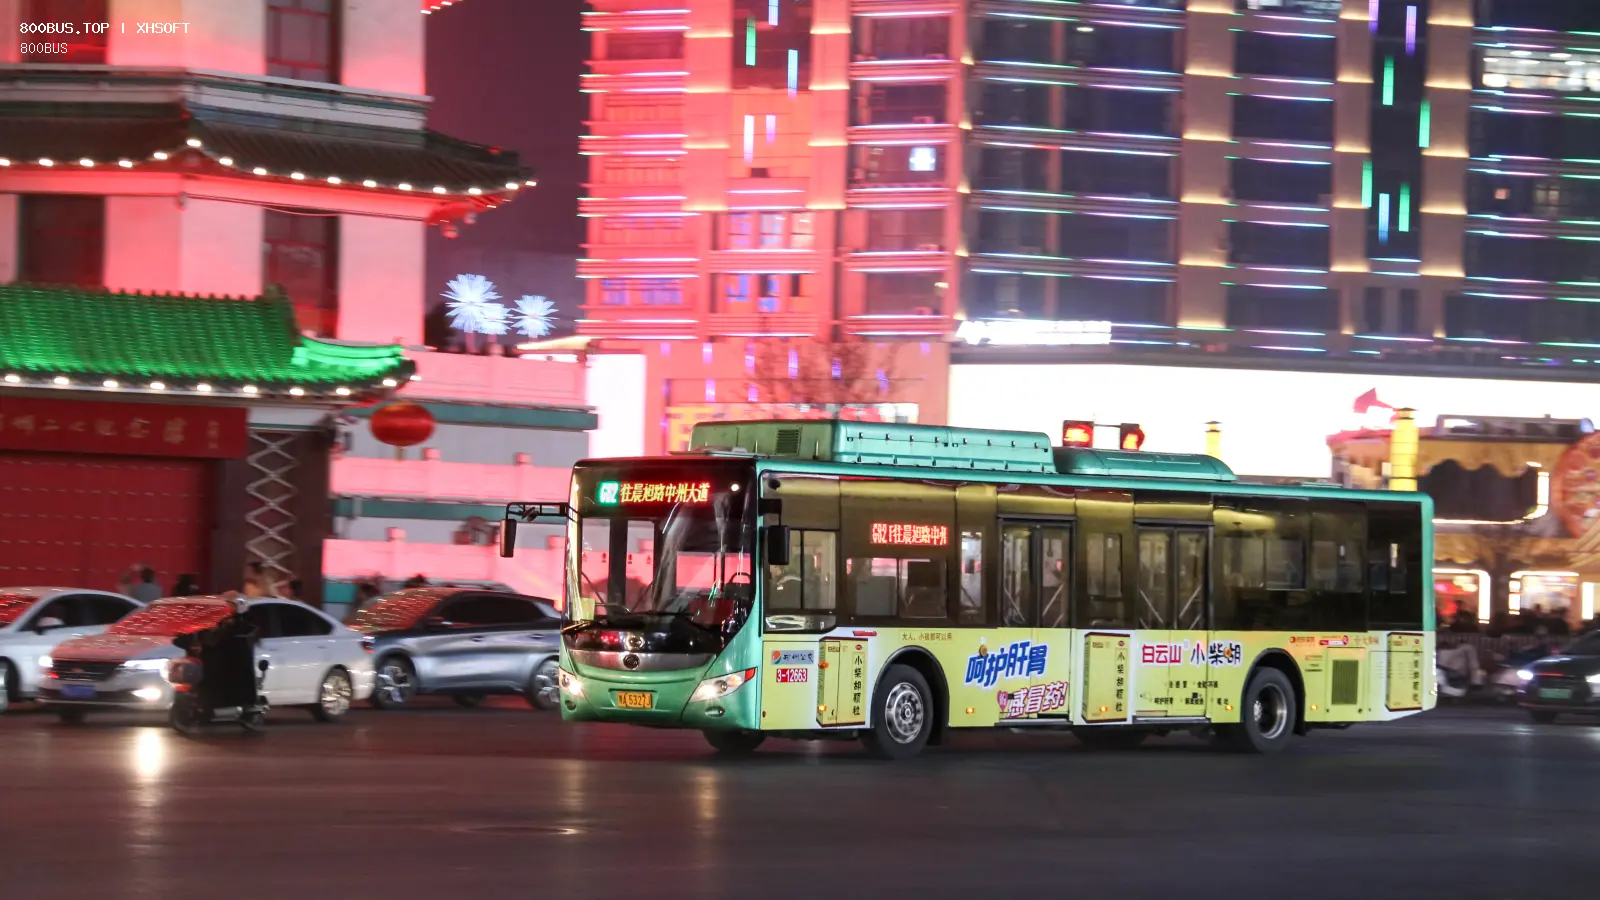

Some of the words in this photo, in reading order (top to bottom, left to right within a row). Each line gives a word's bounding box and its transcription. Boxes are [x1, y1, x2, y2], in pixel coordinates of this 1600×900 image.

[620, 483, 710, 503] 往晨旭路中州大道
[965, 641, 1049, 688] 呵护肝胃
[1142, 644, 1182, 664] 白云山
[1190, 643, 1241, 665] 小柴胡
[777, 668, 807, 683] 3-12663
[852, 655, 863, 716] 小柴胡颗粒
